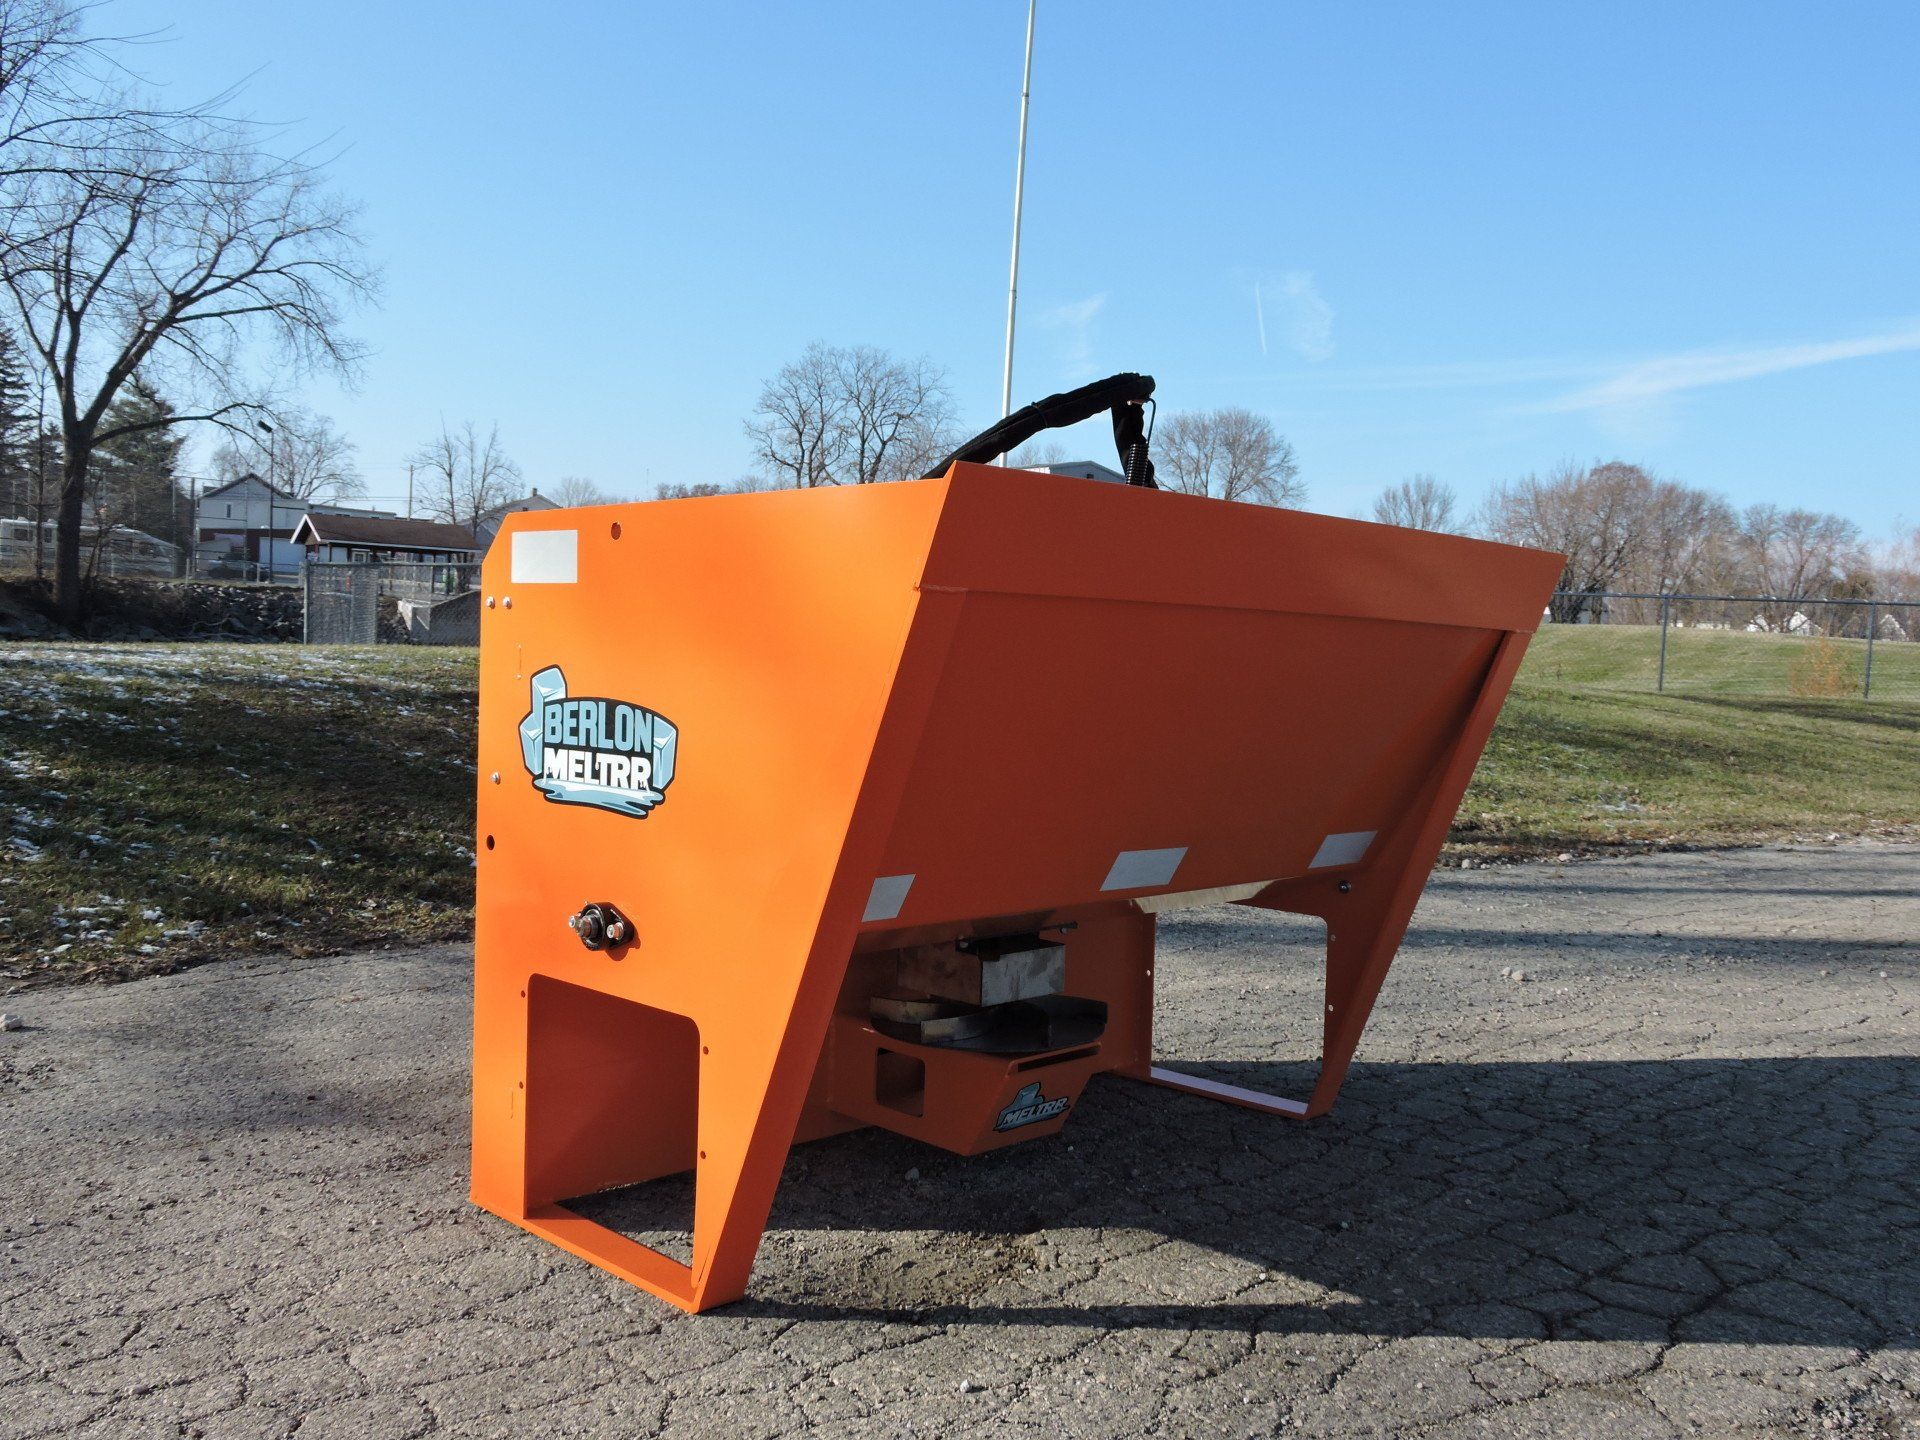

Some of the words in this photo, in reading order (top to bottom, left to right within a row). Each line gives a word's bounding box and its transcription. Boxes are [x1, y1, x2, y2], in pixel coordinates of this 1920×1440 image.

[544, 700, 652, 753] BERLON
[543, 747, 651, 792] MELTRR
[1002, 1097, 1067, 1125] MELTRR
